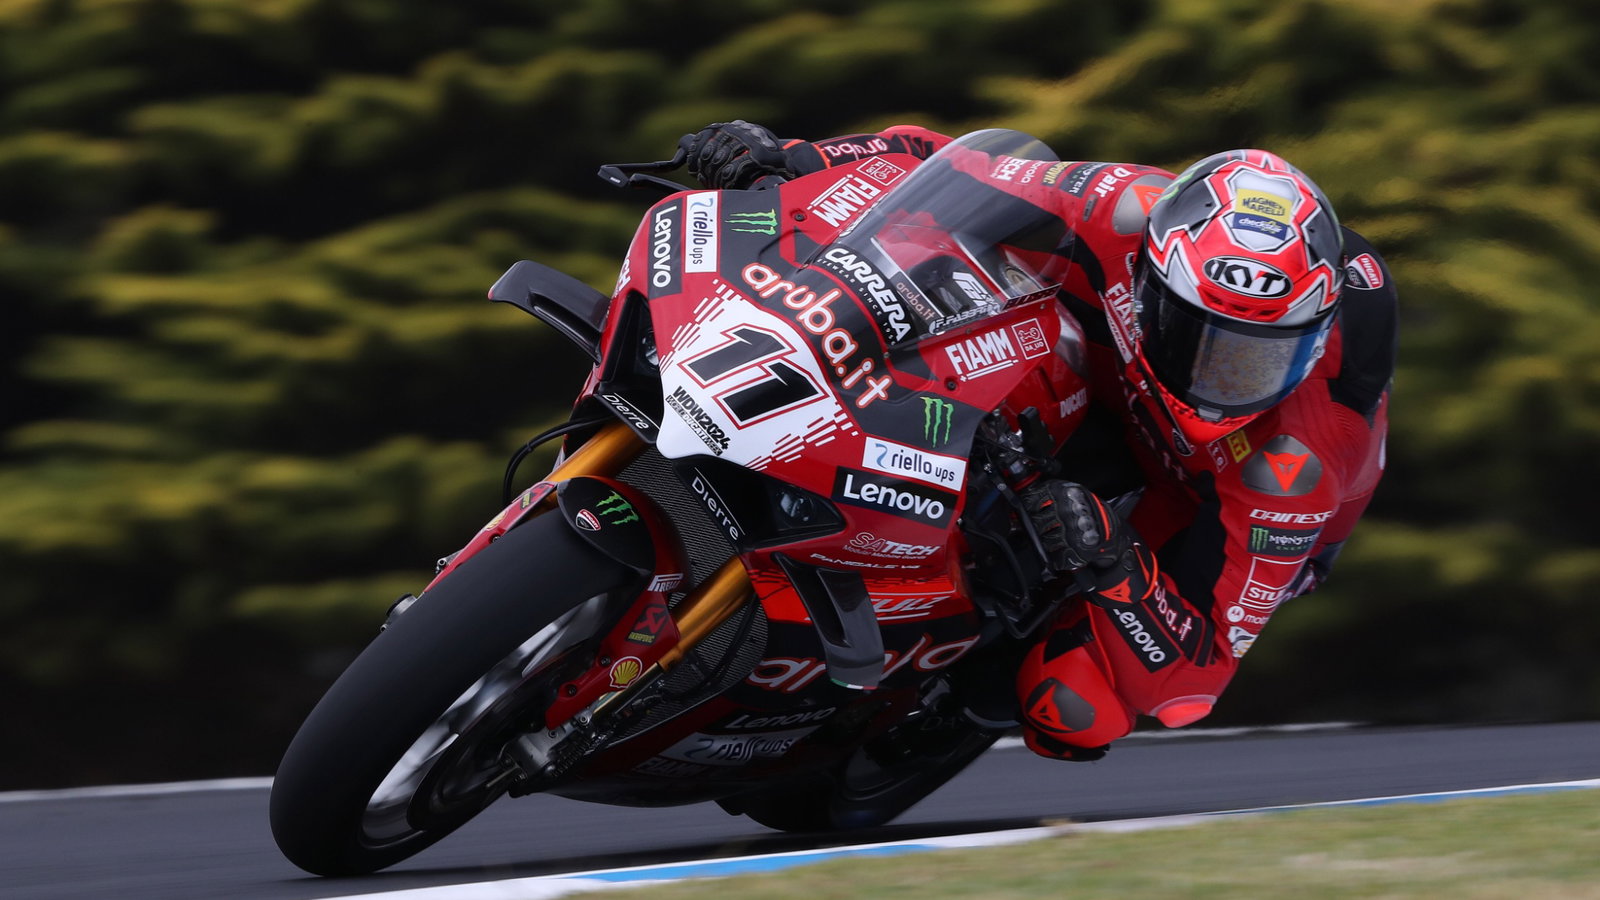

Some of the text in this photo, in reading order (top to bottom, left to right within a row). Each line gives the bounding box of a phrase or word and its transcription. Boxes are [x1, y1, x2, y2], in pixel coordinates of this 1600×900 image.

[812, 177, 881, 228] FIAMM
[652, 205, 677, 288] Lenovo
[689, 211, 713, 265] riello ups
[1212, 263, 1285, 293] KYT
[1360, 257, 1381, 286] DUCATI
[825, 248, 911, 341] CARRERA
[896, 281, 937, 321] aruba.it
[1105, 281, 1132, 325] FIA
[741, 261, 893, 408] aruba.it
[944, 327, 1016, 376] FIAMM
[680, 323, 830, 429] 11
[602, 393, 649, 430] Dierre
[672, 385, 731, 450] WDW2024
[1060, 388, 1088, 418] DUCATI
[891, 449, 955, 482] riello ups
[692, 476, 740, 541] Dierre
[843, 474, 945, 519] Lenovo
[850, 532, 940, 556] SATECH
[647, 573, 684, 592] PIRELLI
[1248, 587, 1286, 601] STU
[724, 706, 837, 729] Lenovo
